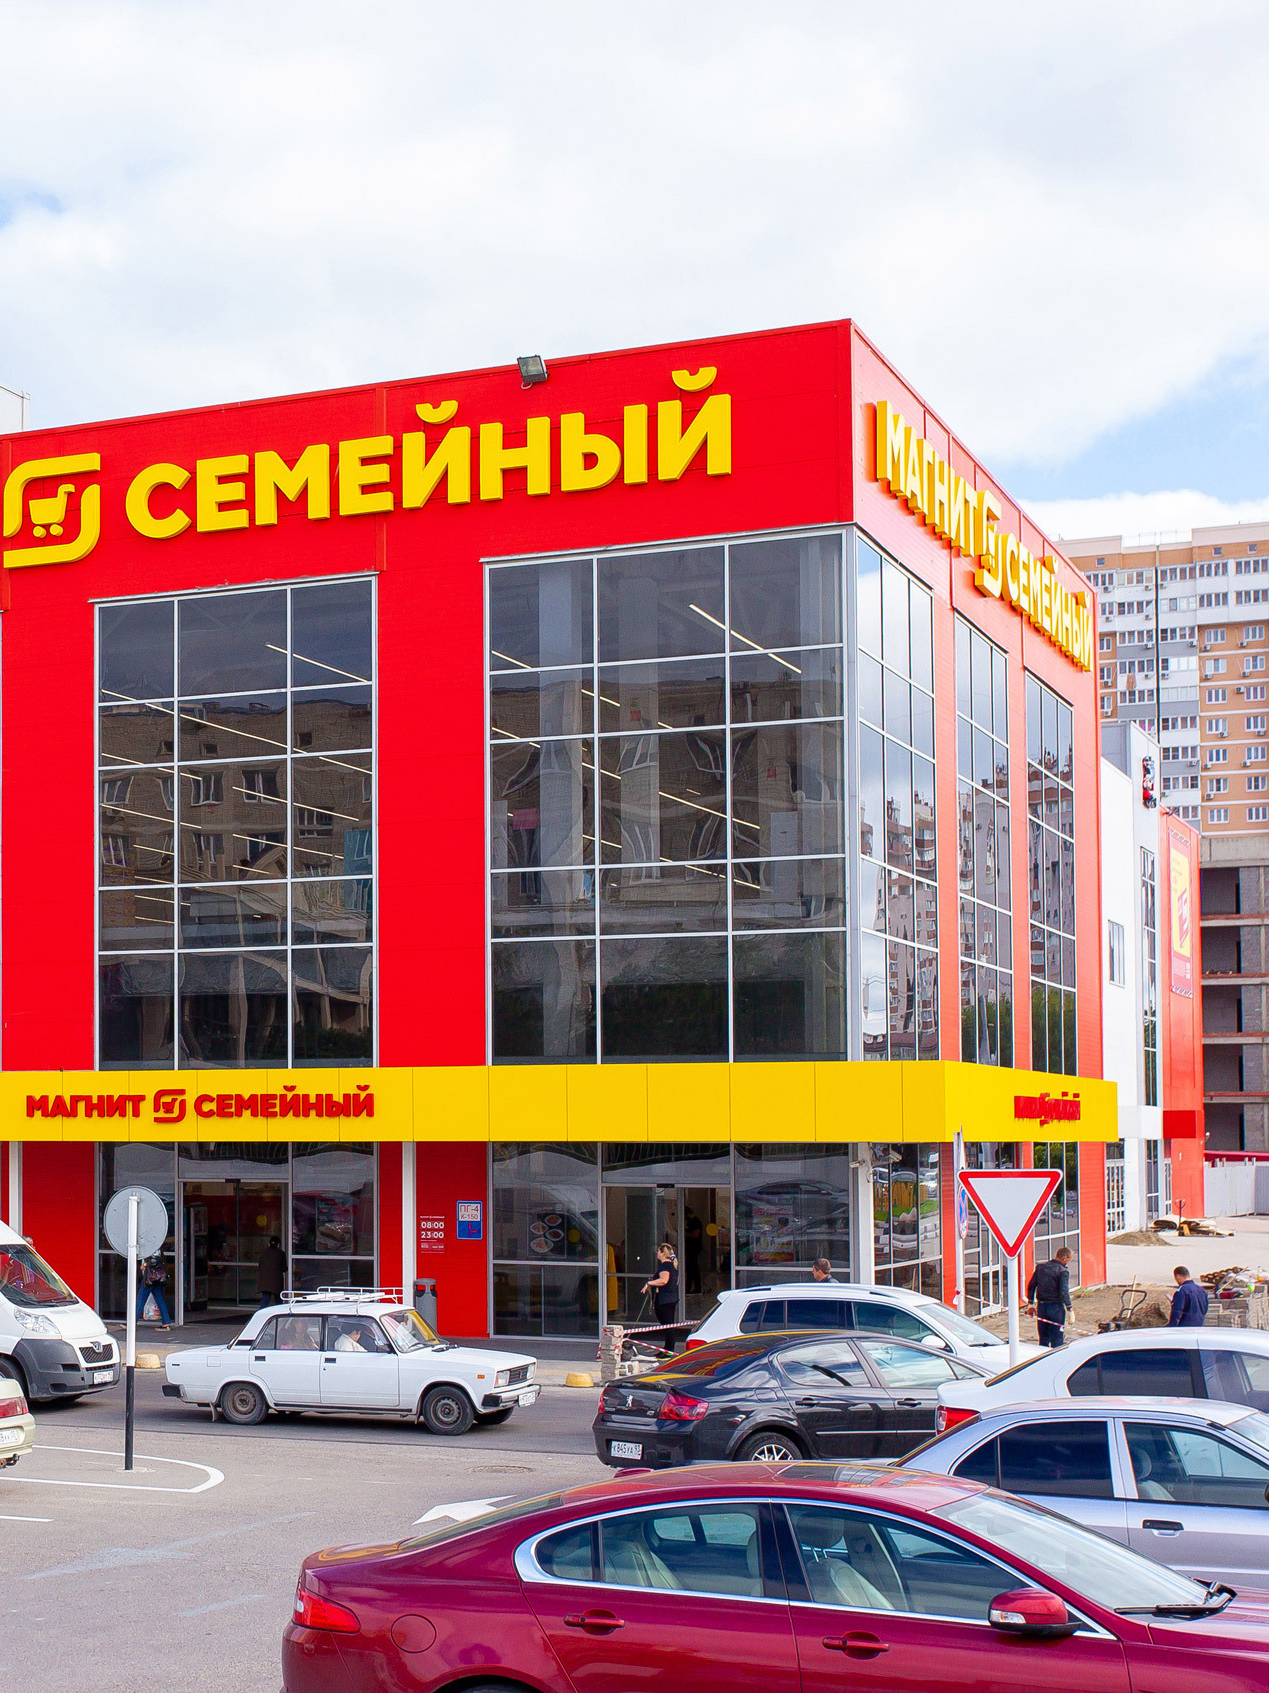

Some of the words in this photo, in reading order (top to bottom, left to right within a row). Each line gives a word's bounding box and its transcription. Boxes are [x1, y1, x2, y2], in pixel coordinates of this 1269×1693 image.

[125, 366, 732, 540] СЕМЕЙНЫЙ
[876, 400, 979, 558] МАГНИТ
[1001, 533, 1094, 673] СЕМЕЙНЫЙ
[26, 1094, 146, 1118] МАГНИТ
[194, 1085, 375, 1118] СЕМЕЙНЫЙ
[459, 1204, 479, 1213] ПГ-4
[421, 1221, 445, 1229] 08:00
[421, 1231, 445, 1239] 23:00
